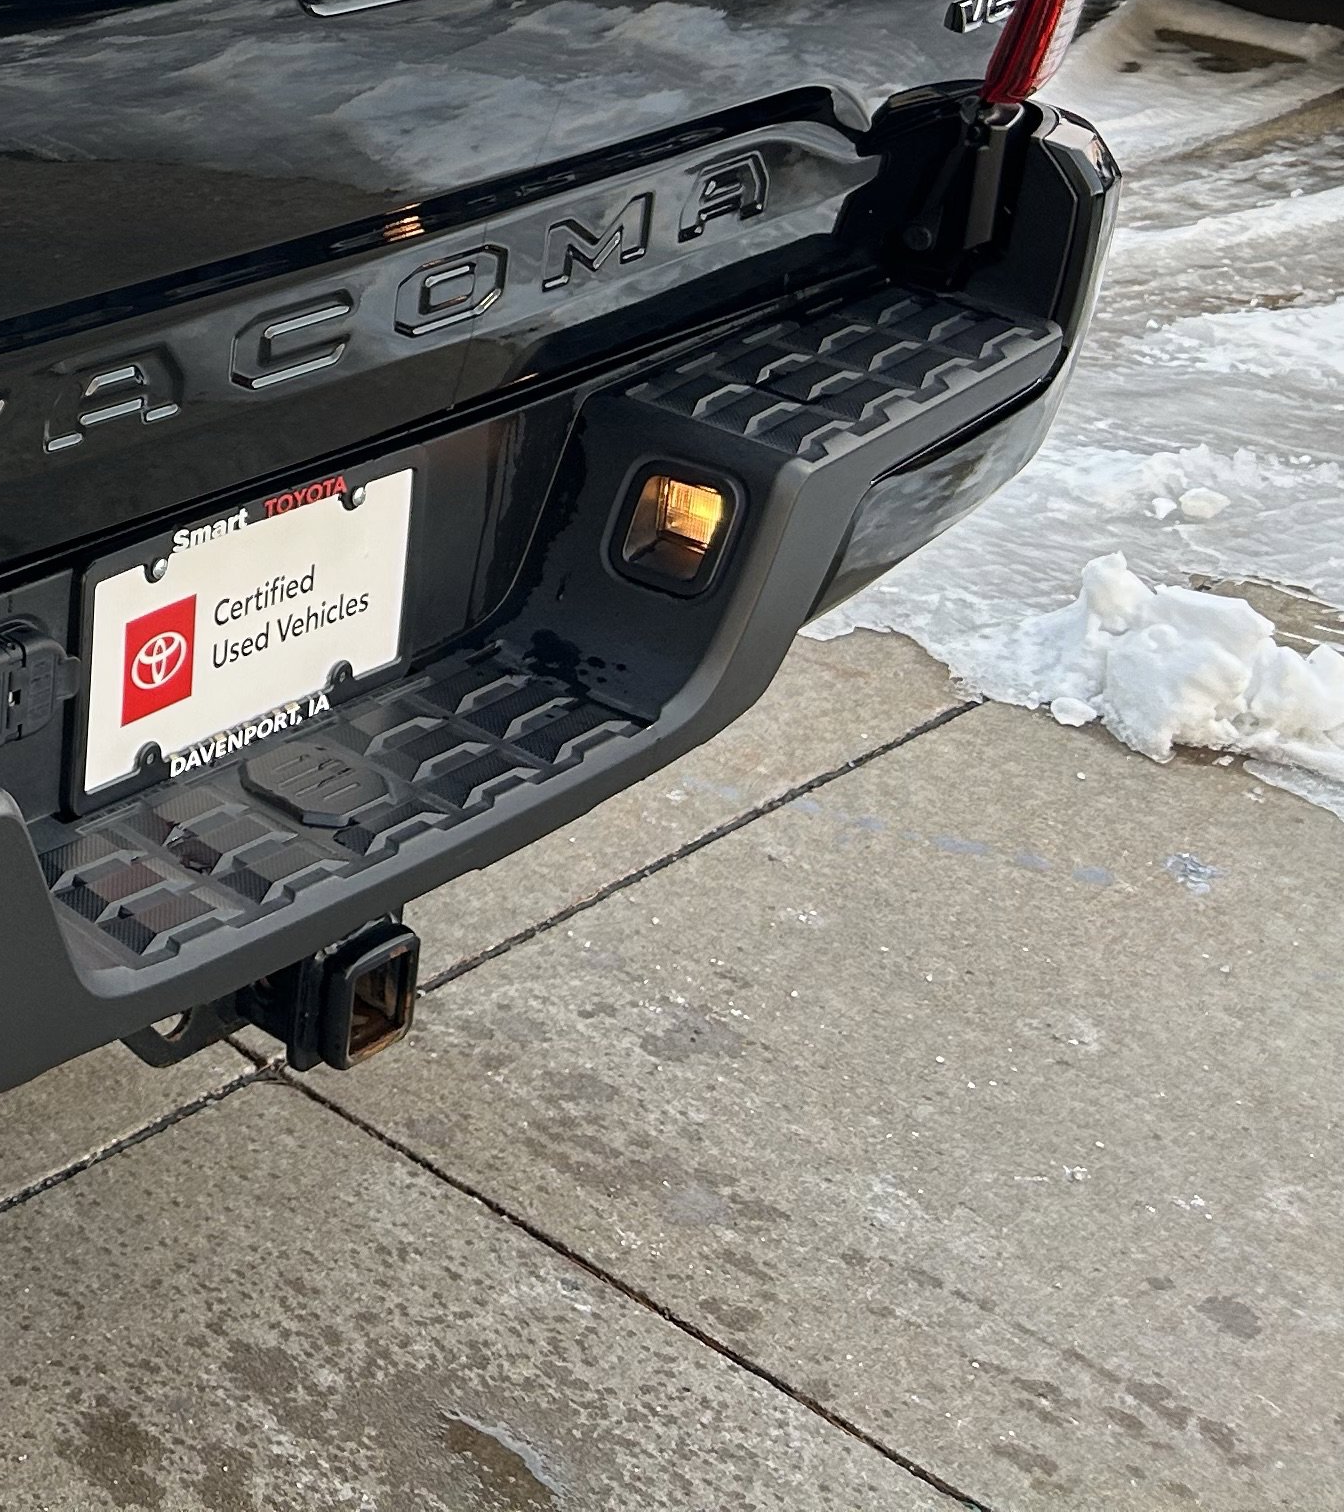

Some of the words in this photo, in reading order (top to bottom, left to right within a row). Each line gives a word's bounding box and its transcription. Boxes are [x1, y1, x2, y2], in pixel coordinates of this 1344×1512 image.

[172, 507, 249, 553] Smart
[263, 476, 348, 519] TOYOTA
[212, 622, 270, 669] Used
[277, 592, 370, 643] Vehicles
[214, 564, 316, 626] Certified
[169, 704, 304, 779] DAVENPORT,
[308, 693, 331, 717] IA
